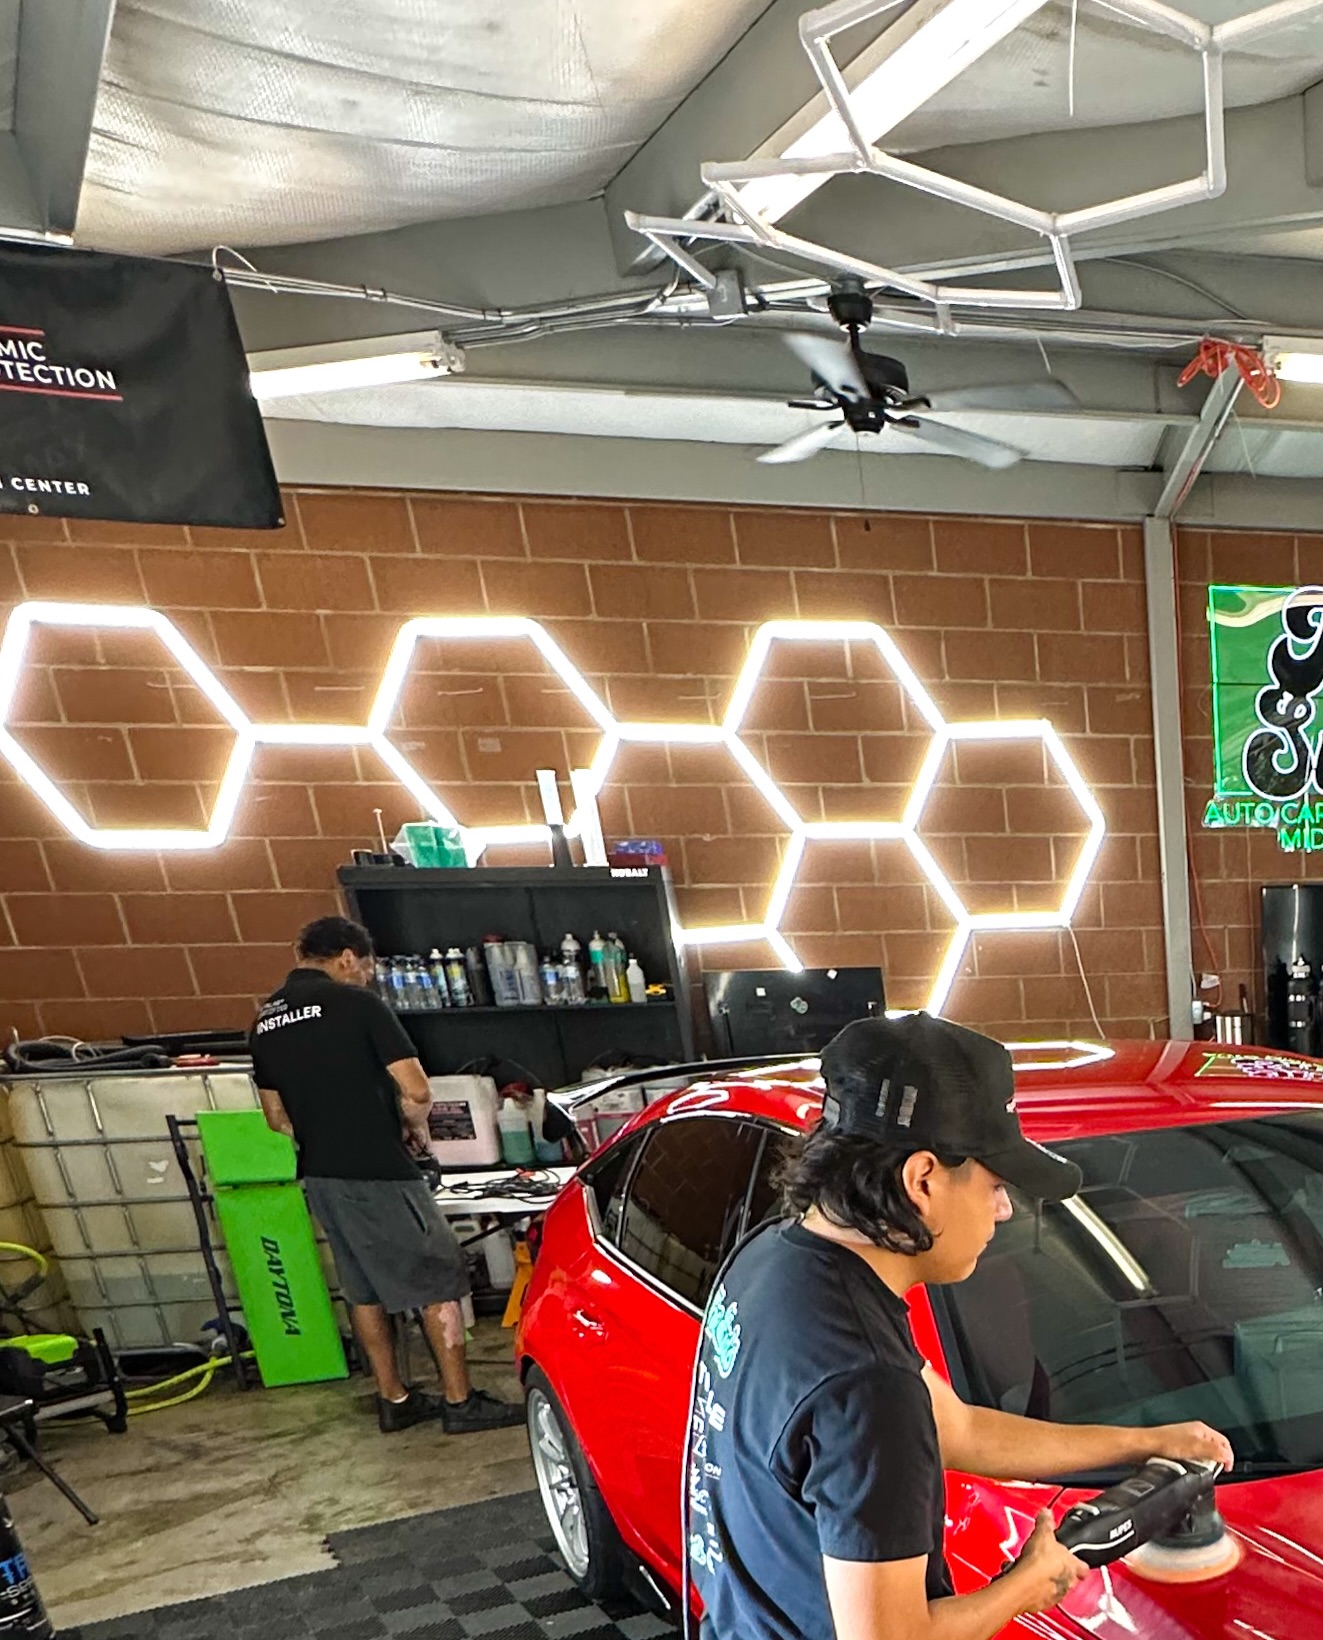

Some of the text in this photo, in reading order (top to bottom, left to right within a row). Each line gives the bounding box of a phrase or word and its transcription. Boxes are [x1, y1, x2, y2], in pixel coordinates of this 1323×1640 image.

[11, 477, 91, 496] CENTER
[1203, 802, 1275, 825] AUTO
[256, 1005, 322, 1035] INSTALLER
[260, 1235, 302, 1336] DAYTONA
